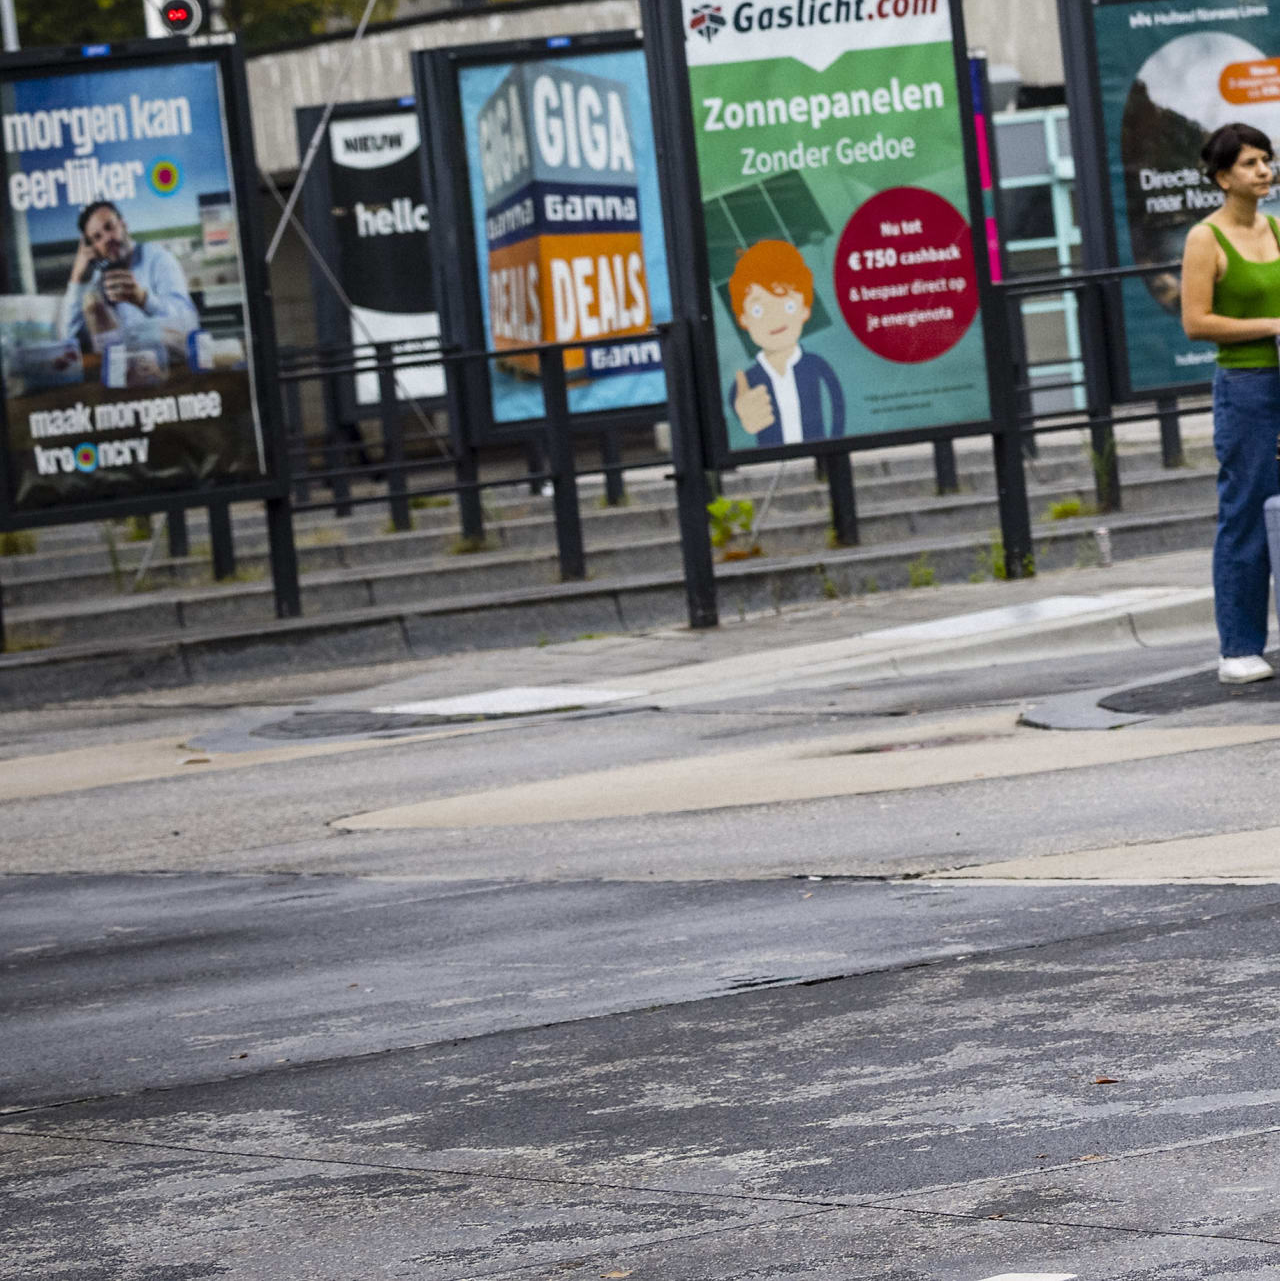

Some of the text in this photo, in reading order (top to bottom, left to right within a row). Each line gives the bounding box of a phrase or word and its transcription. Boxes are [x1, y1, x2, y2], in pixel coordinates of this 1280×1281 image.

[3, 93, 193, 155] morgen kan
[533, 74, 634, 174] GIGA
[702, 76, 945, 132] Zonnepanelen
[343, 132, 404, 153] NIEUW
[740, 132, 916, 175] Zonder Gedoe
[9, 156, 144, 212] eerlijker
[863, 247, 898, 269] 750
[899, 243, 961, 265] cashback
[550, 251, 648, 343] DEALS
[29, 402, 94, 439] maak
[94, 396, 179, 433] morgen
